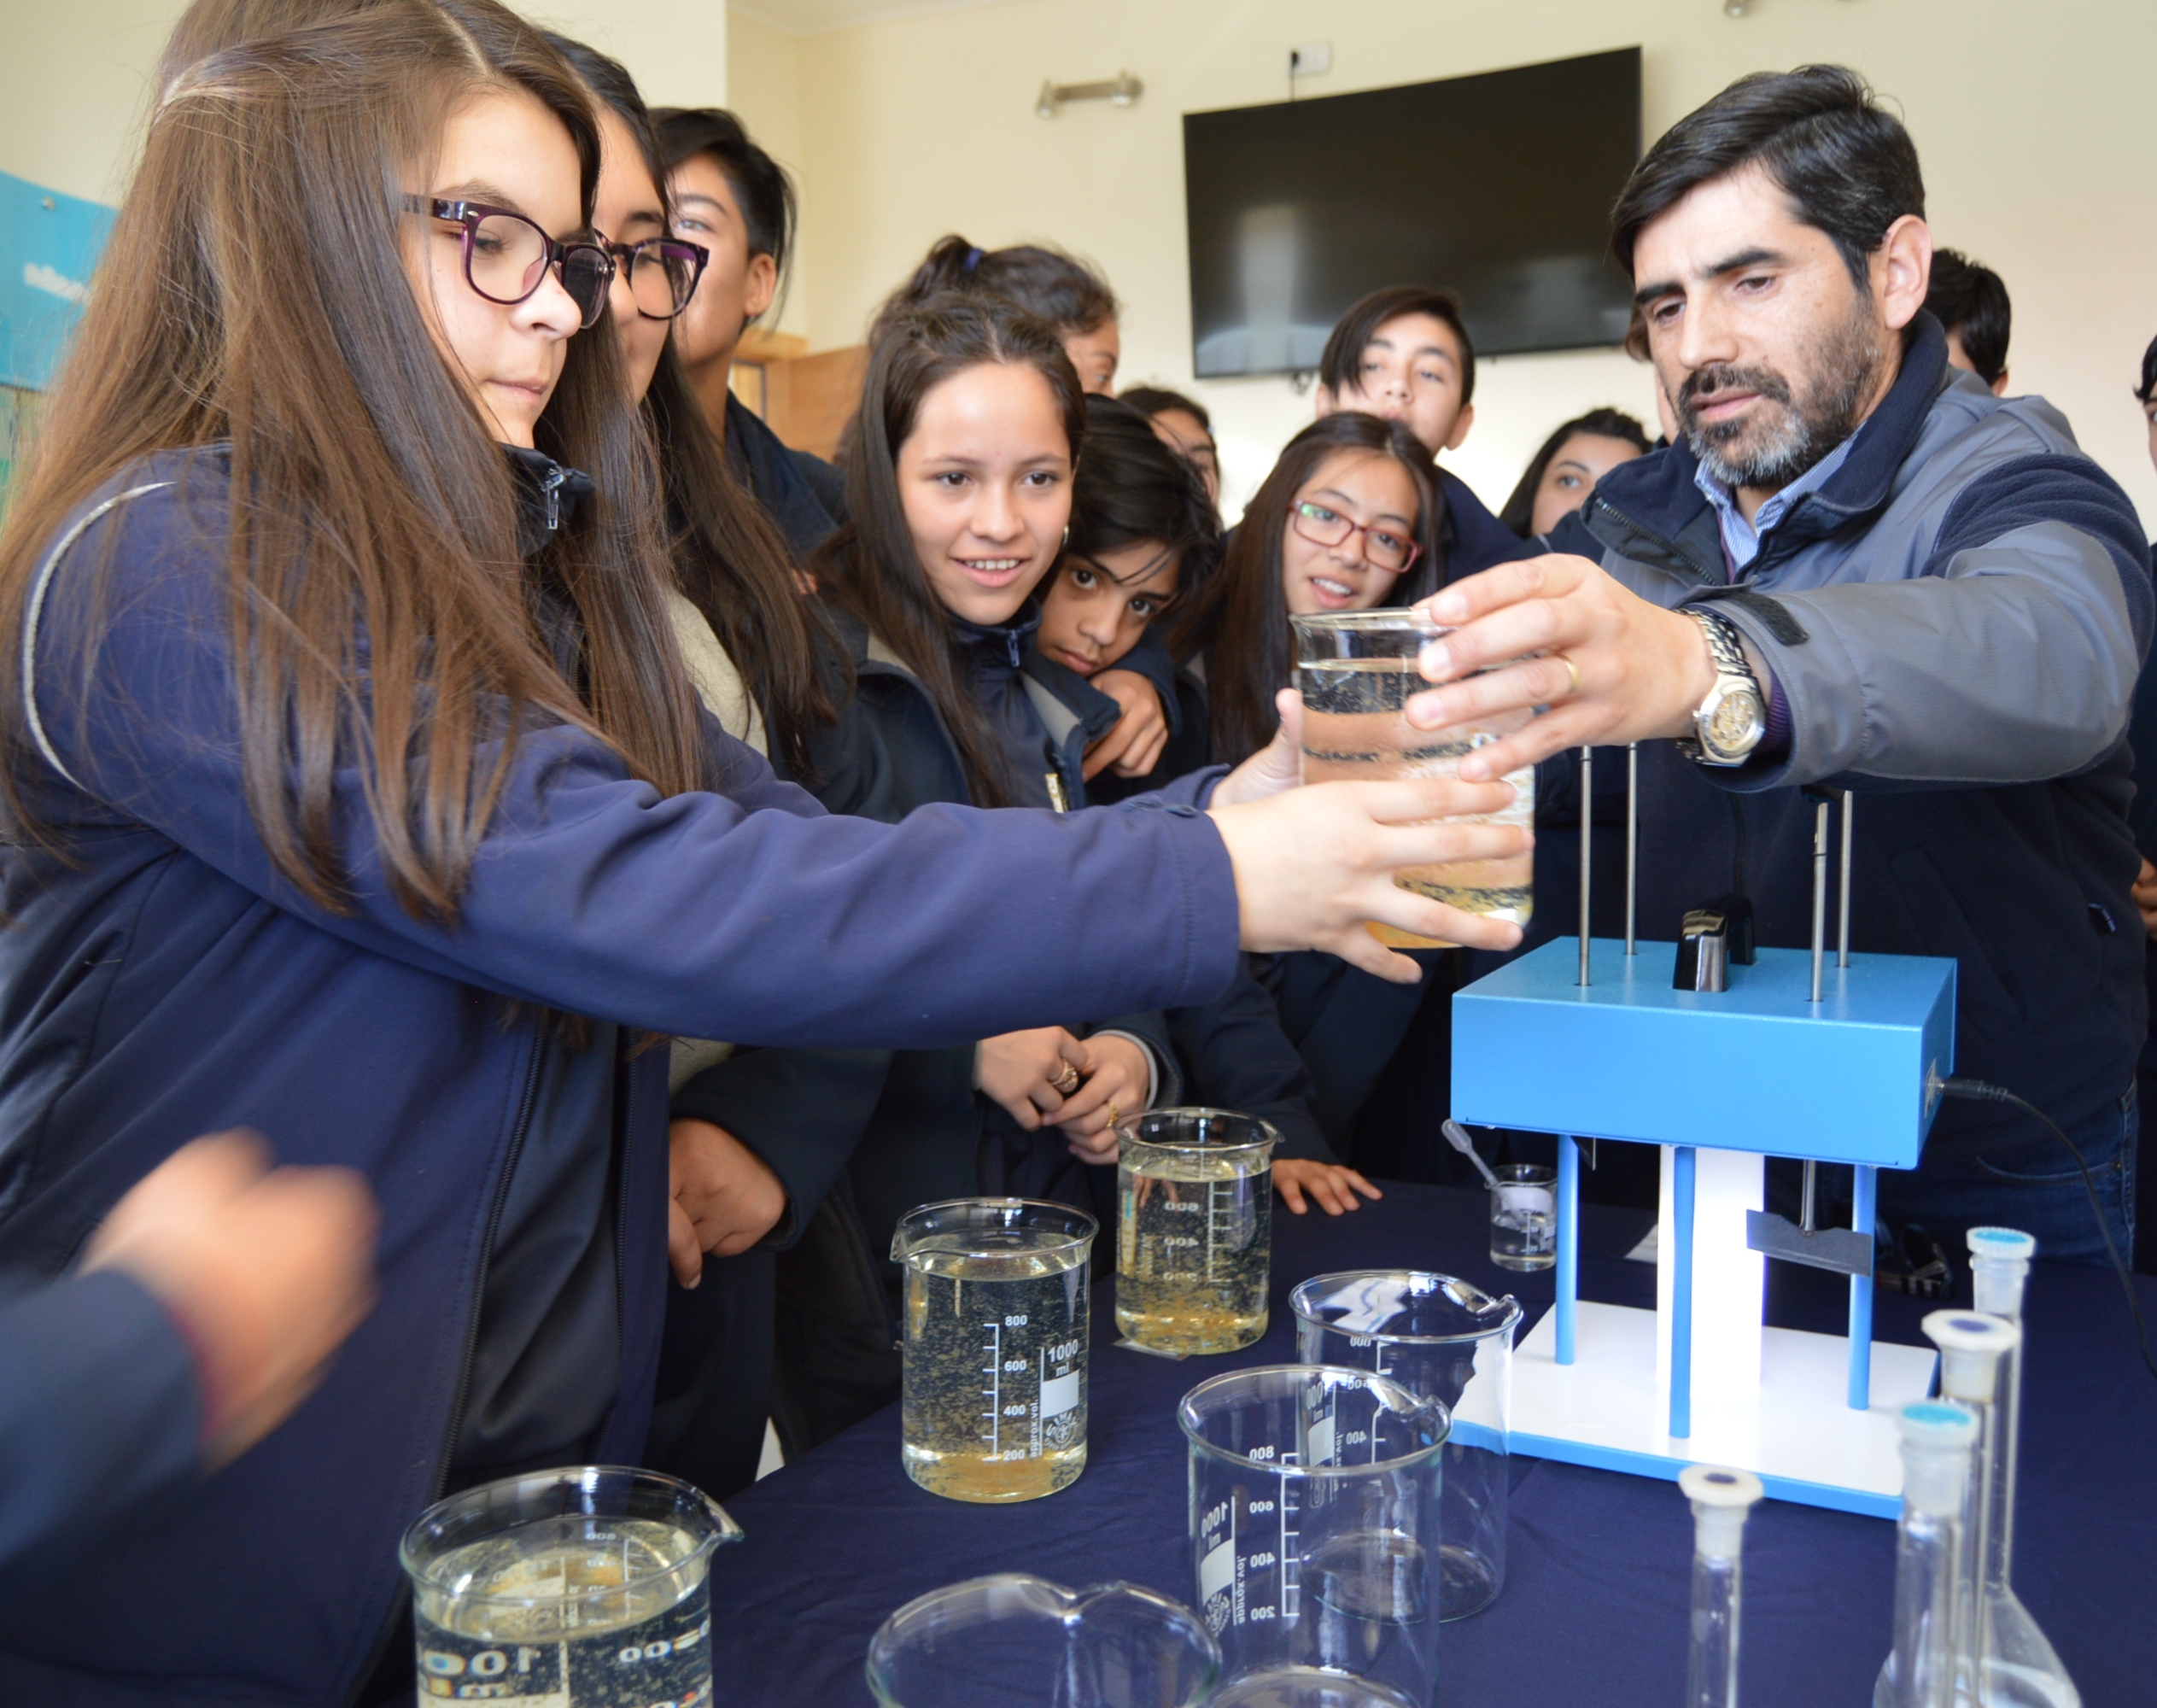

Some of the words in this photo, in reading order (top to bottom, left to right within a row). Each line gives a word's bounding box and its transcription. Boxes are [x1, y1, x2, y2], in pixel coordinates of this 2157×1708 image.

[1005, 1314, 1028, 1327] 800
[1047, 1338, 1078, 1364] 1000
[1003, 1360, 1027, 1372] 600
[1055, 1360, 1070, 1378] ml
[1003, 1404, 1026, 1417] 400
[1003, 1449, 1026, 1462] 200
